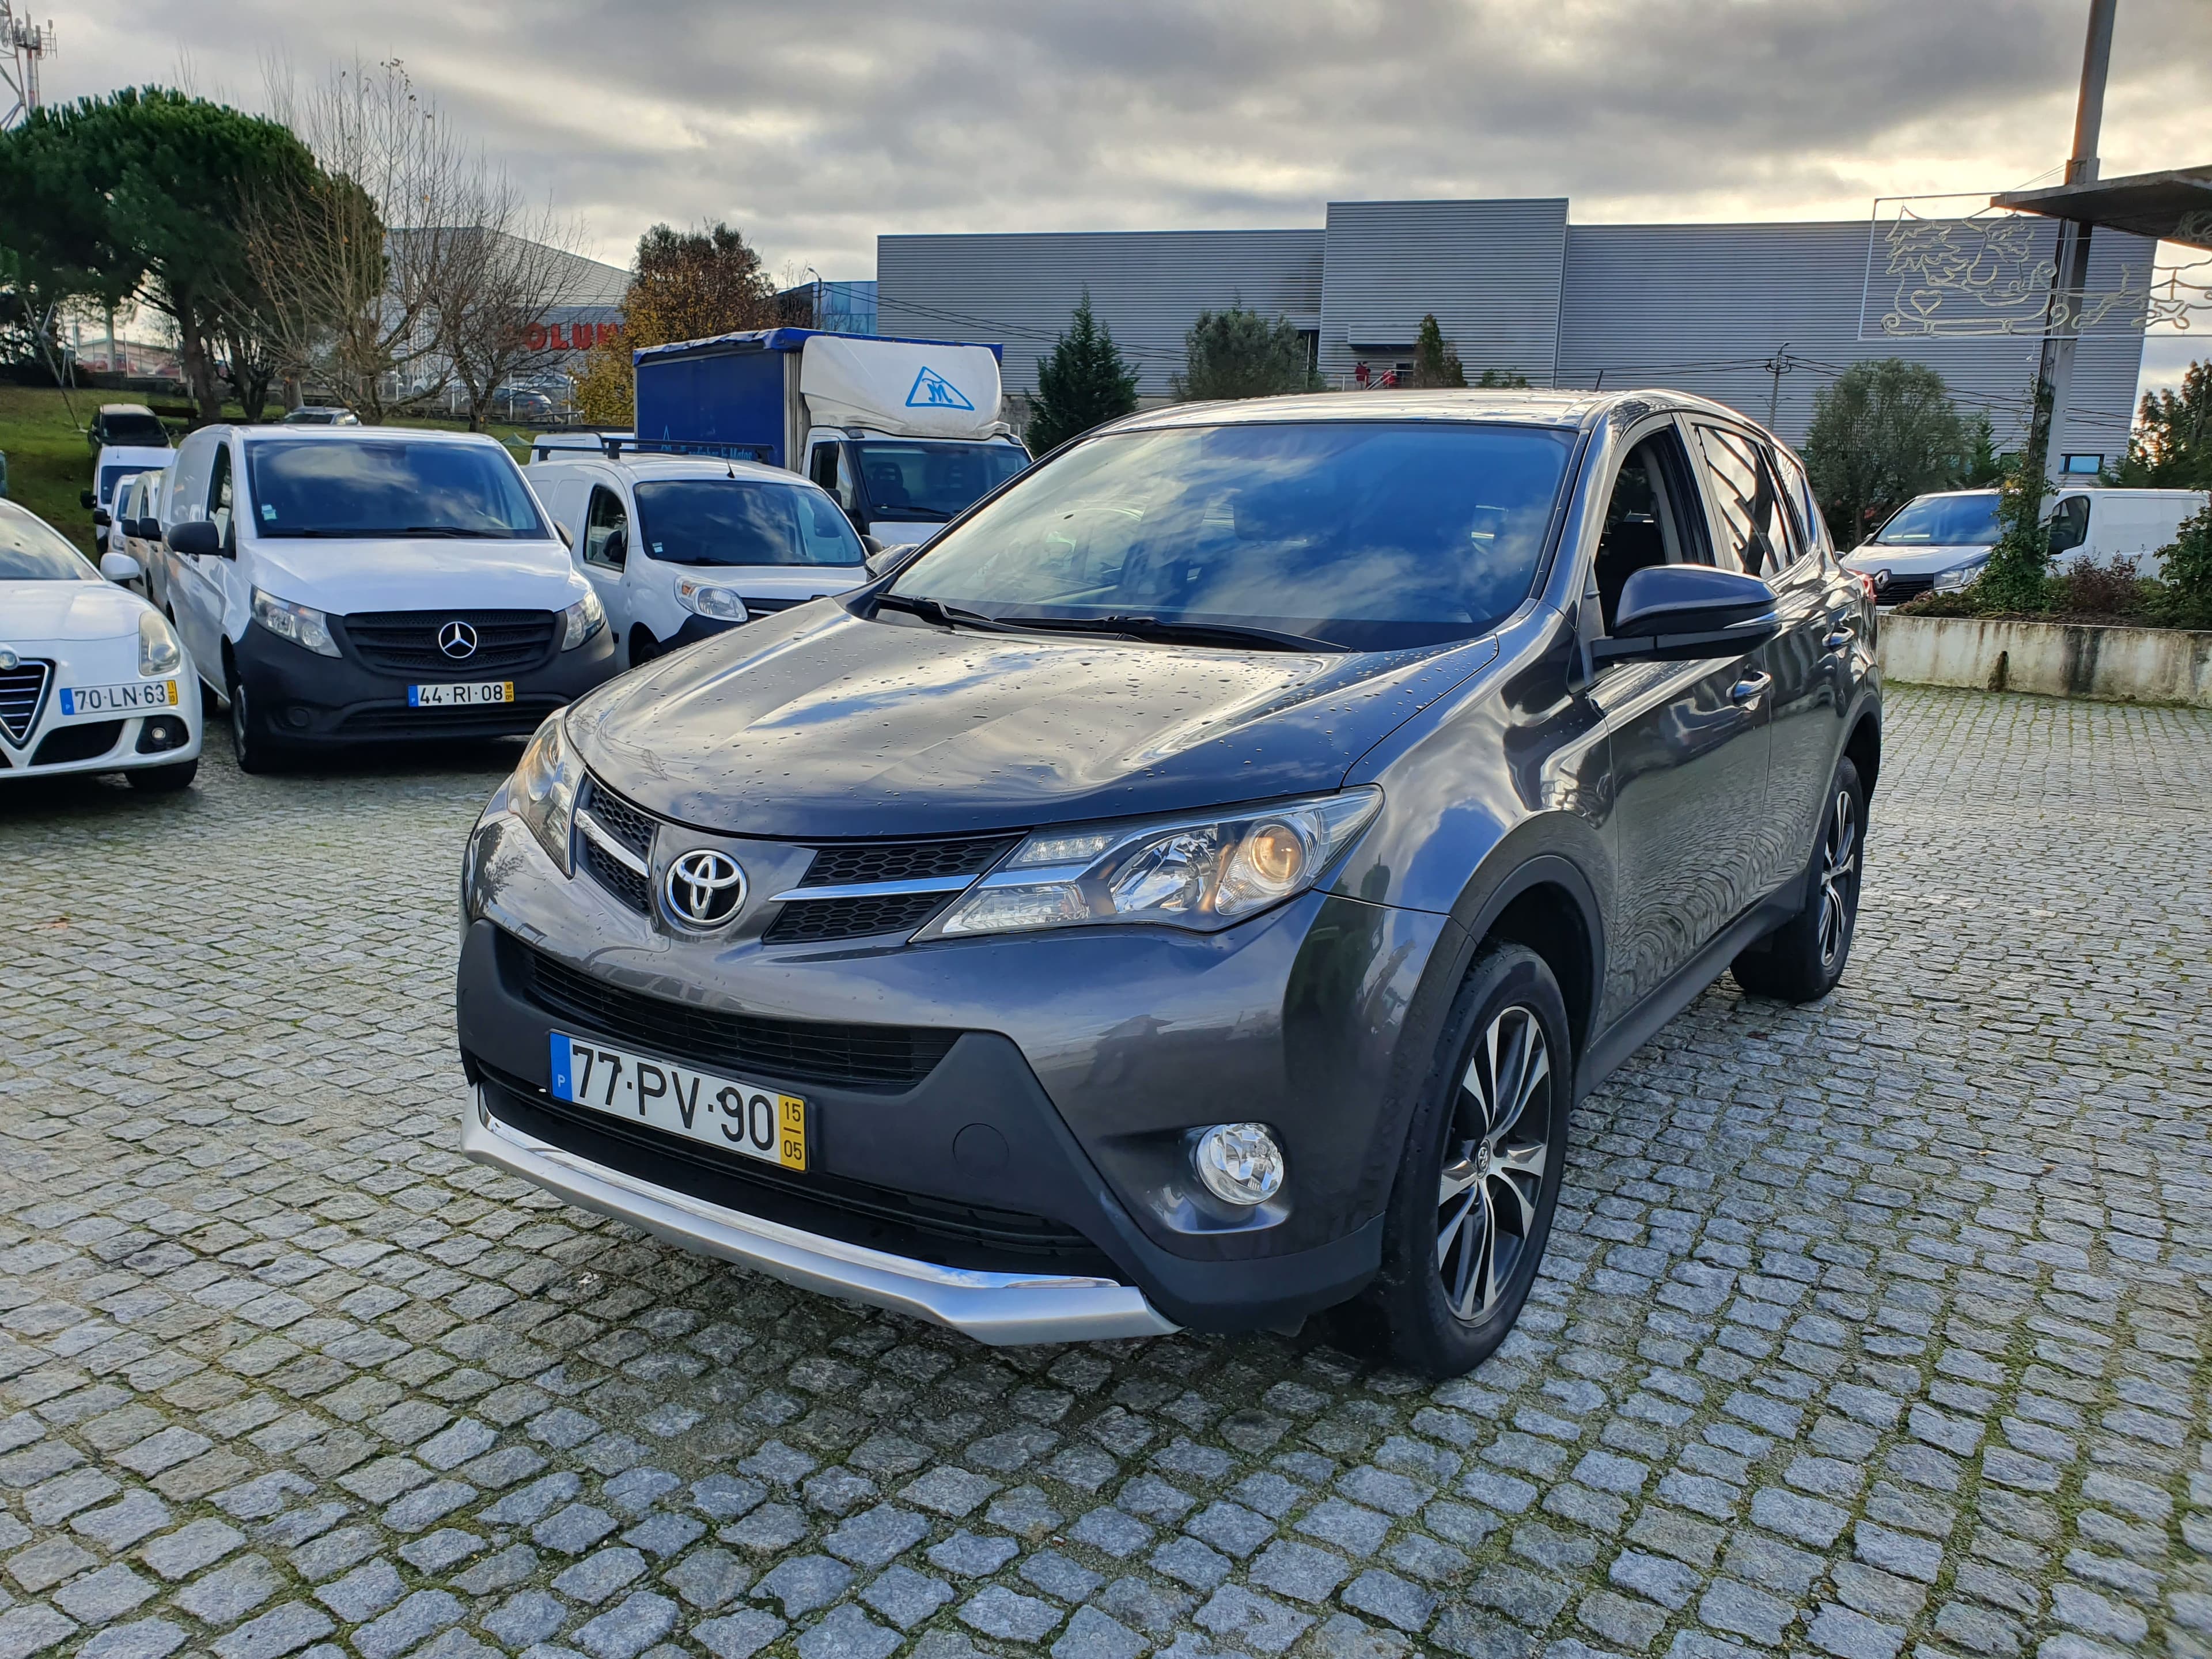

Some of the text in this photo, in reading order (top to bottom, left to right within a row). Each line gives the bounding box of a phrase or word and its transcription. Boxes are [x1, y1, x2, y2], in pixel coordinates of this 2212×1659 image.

[557, 1074, 566, 1088] P
[785, 1101, 801, 1122] 15
[784, 1139, 802, 1161] 05
